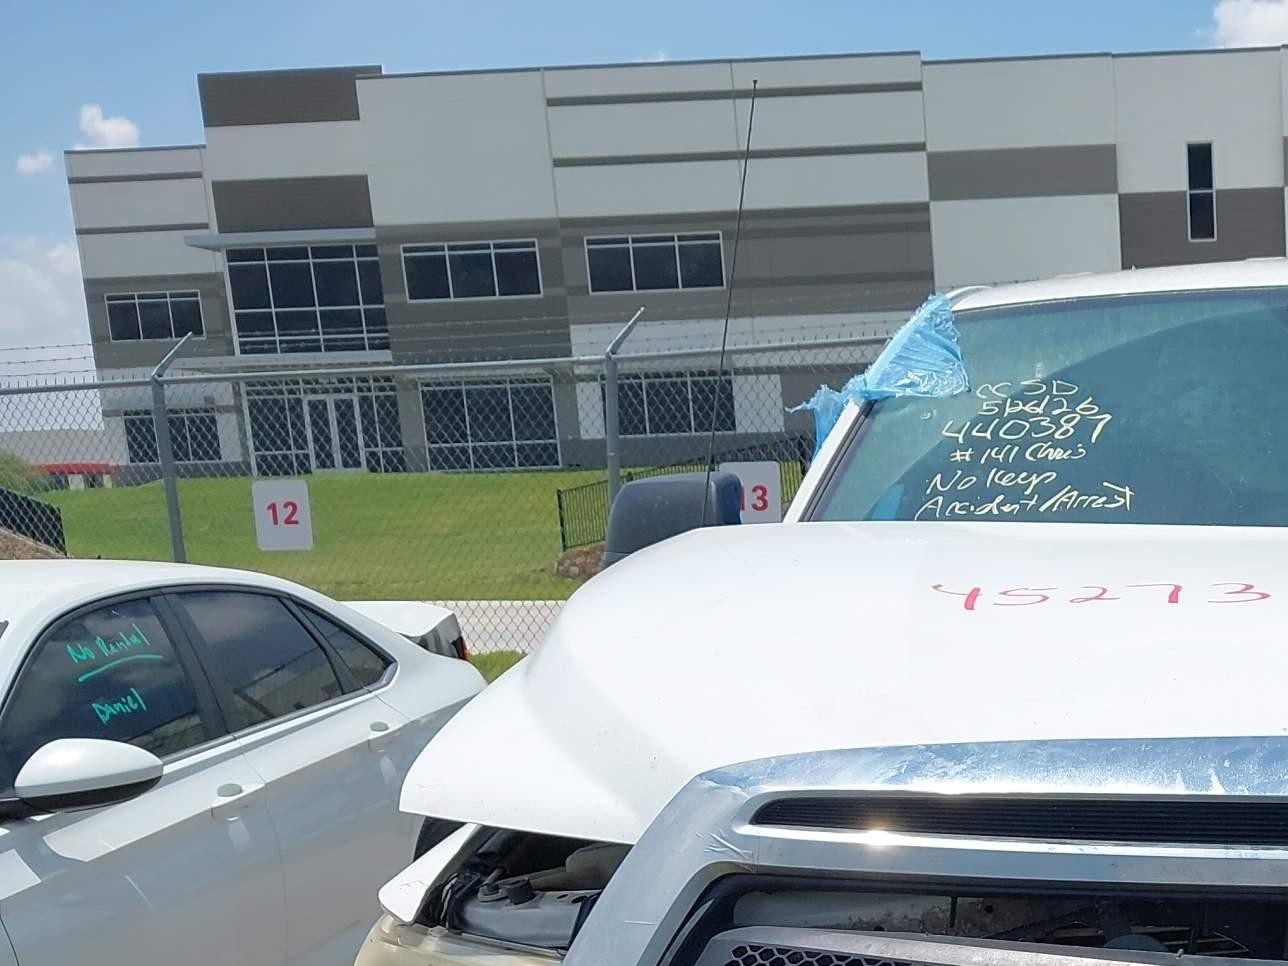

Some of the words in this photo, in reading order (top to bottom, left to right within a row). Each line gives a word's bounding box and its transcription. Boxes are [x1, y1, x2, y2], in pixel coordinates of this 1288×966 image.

[942, 413, 1112, 444] 440387
[1024, 443, 1087, 462] Chris
[925, 470, 977, 495] No
[266, 501, 300, 526] 12
[91, 687, 147, 724] Daniel
